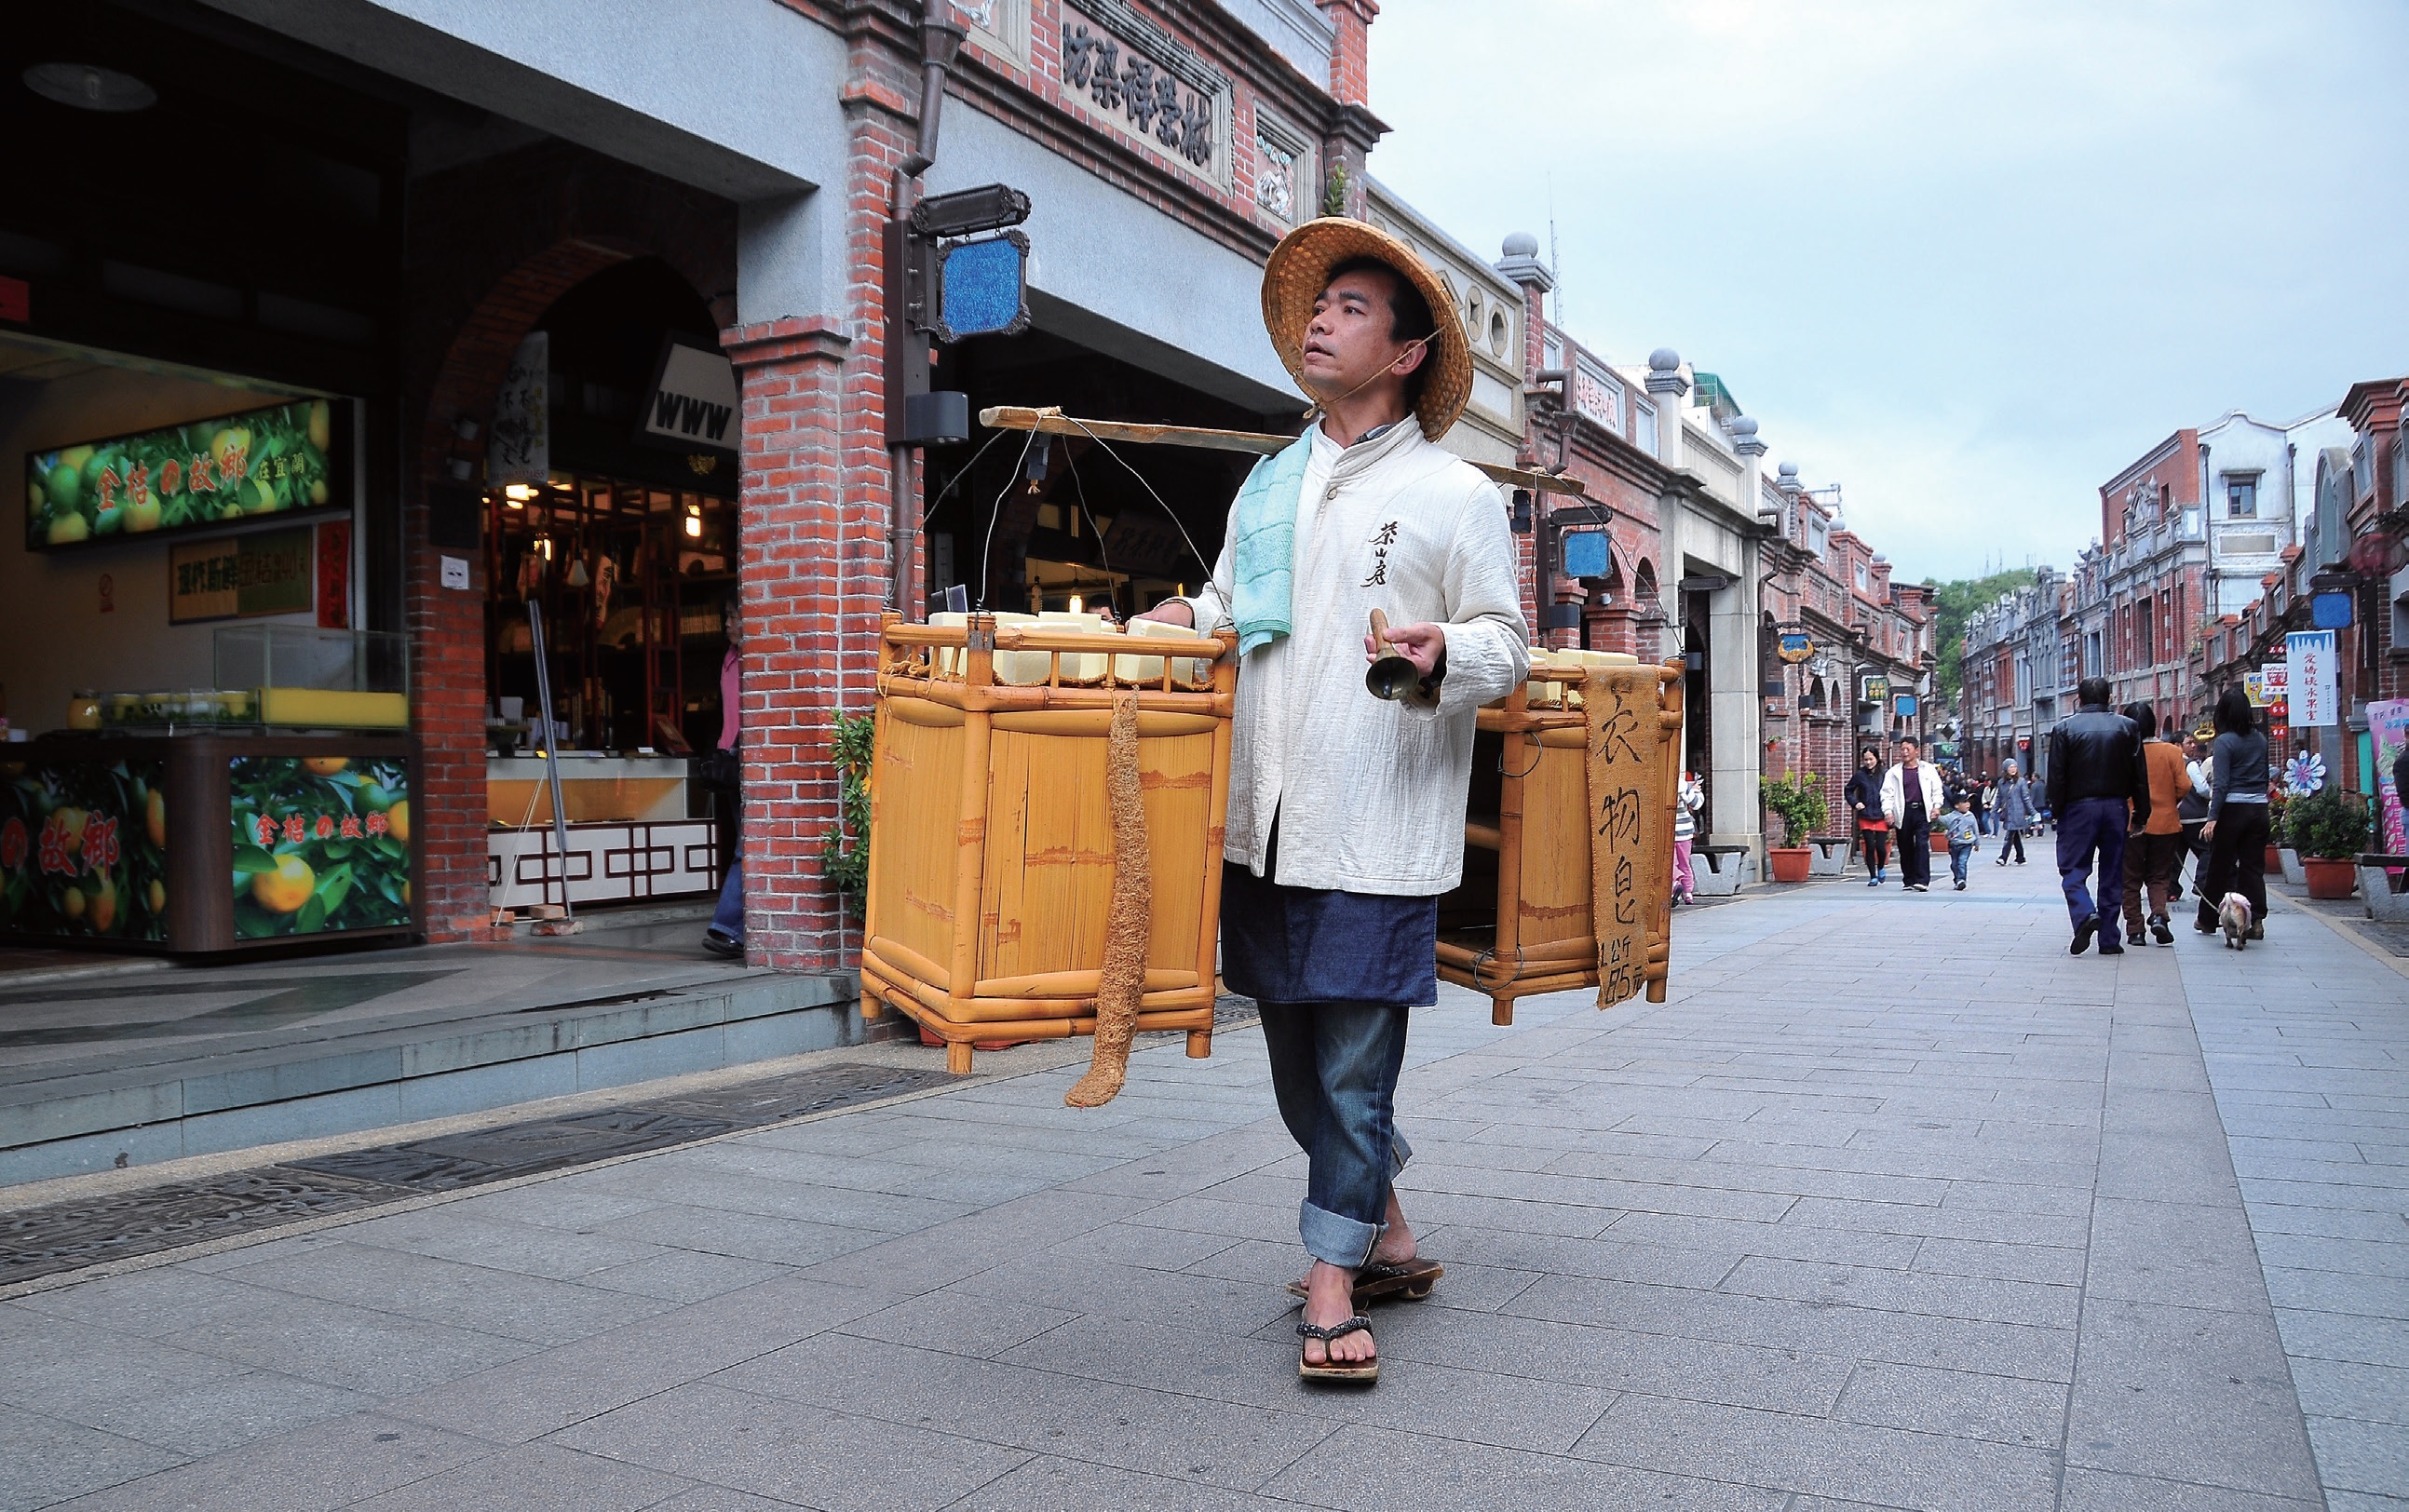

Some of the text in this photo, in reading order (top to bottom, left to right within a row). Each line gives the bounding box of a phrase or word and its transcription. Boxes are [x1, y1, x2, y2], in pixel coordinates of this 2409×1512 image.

[655, 390, 733, 441] WWW
[1360, 520, 1399, 588] 茶山房
[1601, 935, 1631, 967] 1公斤
